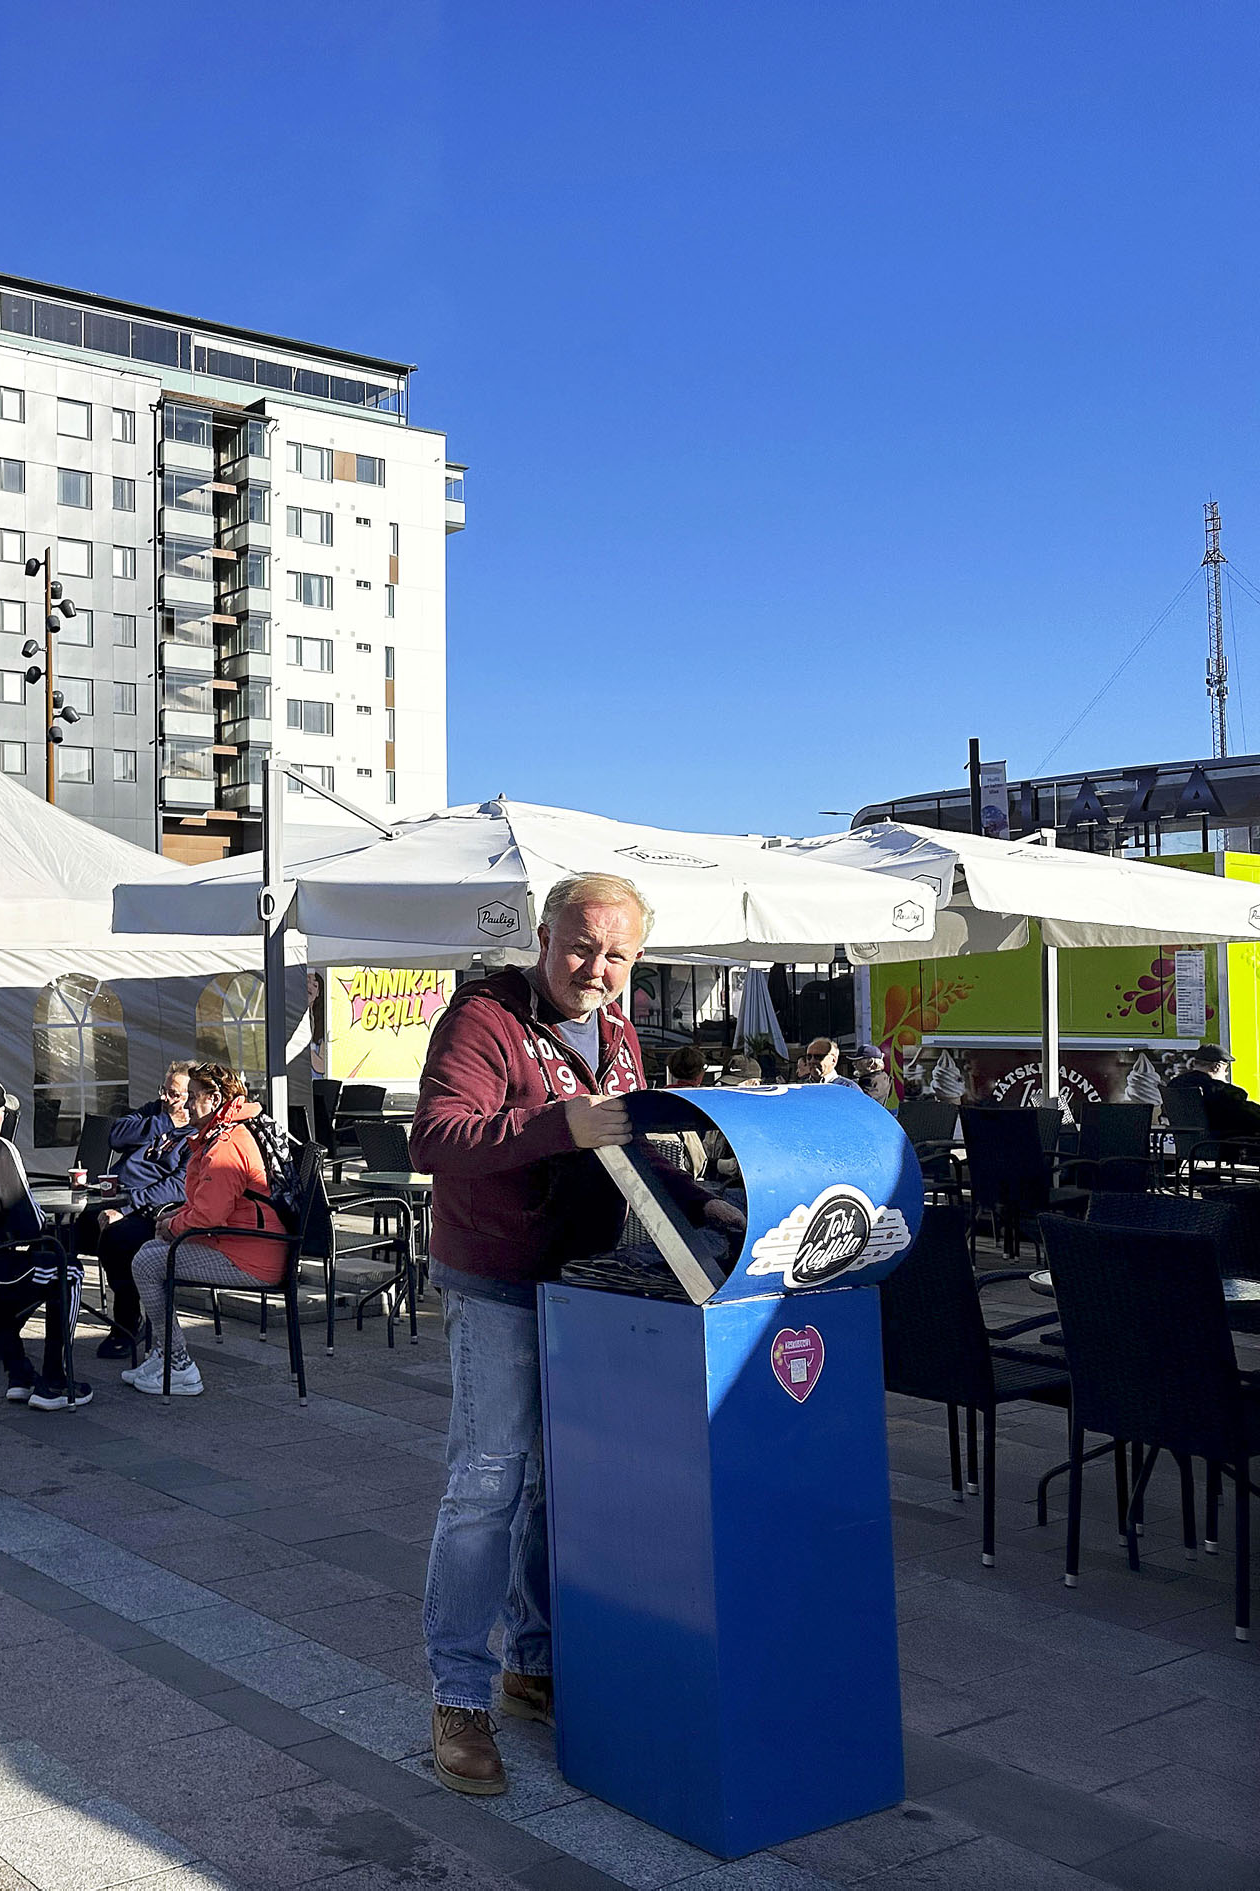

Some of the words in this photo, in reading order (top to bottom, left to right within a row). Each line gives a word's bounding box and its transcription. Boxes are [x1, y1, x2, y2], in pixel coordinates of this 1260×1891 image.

[1020, 763, 1228, 832] LAZA
[482, 911, 515, 928] Paulig
[348, 969, 438, 1001] ANNIKA
[361, 996, 425, 1031] GRILL
[824, 1208, 856, 1244] Tori
[793, 1232, 862, 1273] Kaffila
